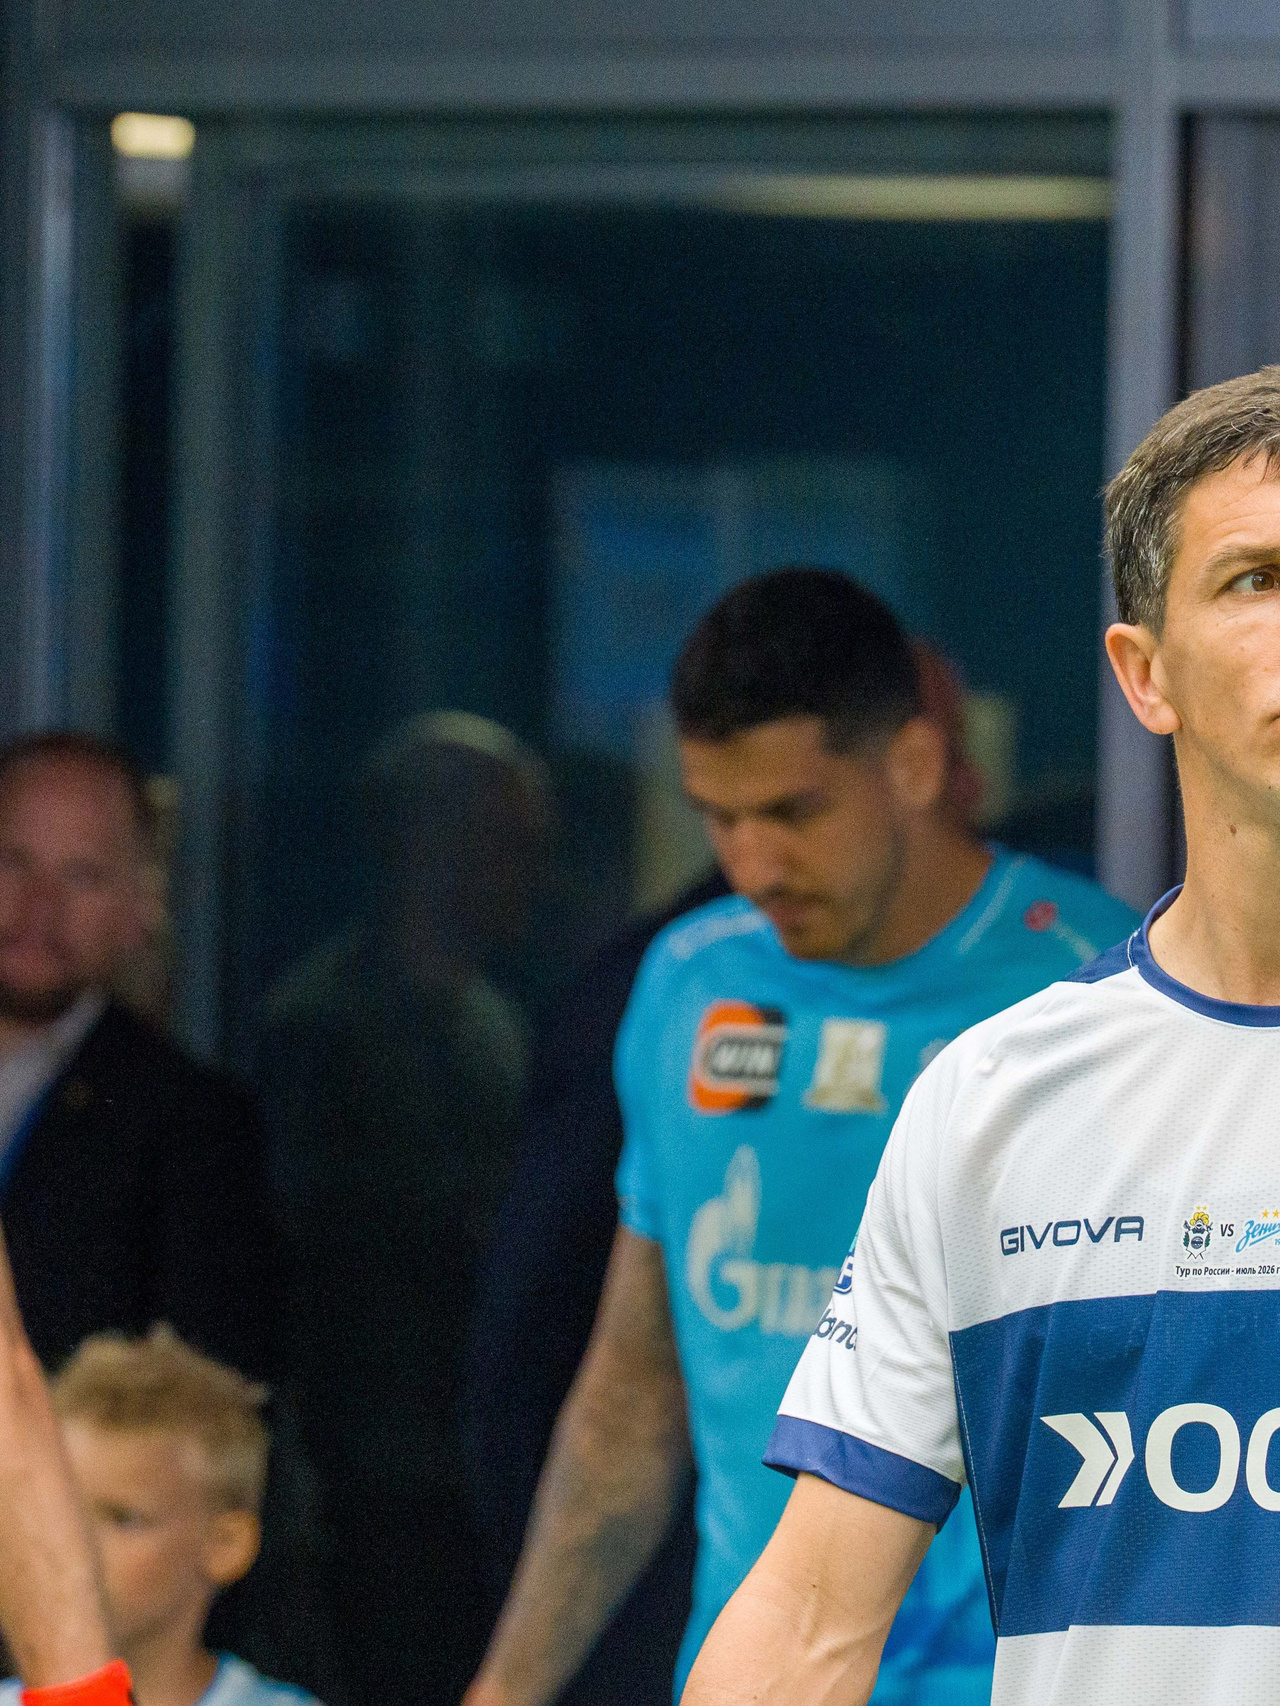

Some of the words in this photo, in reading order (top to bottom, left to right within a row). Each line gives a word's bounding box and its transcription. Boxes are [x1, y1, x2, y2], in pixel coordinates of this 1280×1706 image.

[999, 1215, 1145, 1257] GIVOVA
[1220, 1223, 1234, 1237] VS
[1175, 1265, 1190, 1277] Тур
[1192, 1268, 1203, 1276] по
[1204, 1266, 1230, 1275] России
[1235, 1267, 1257, 1275] июль
[1257, 1265, 1275, 1275] 2026
